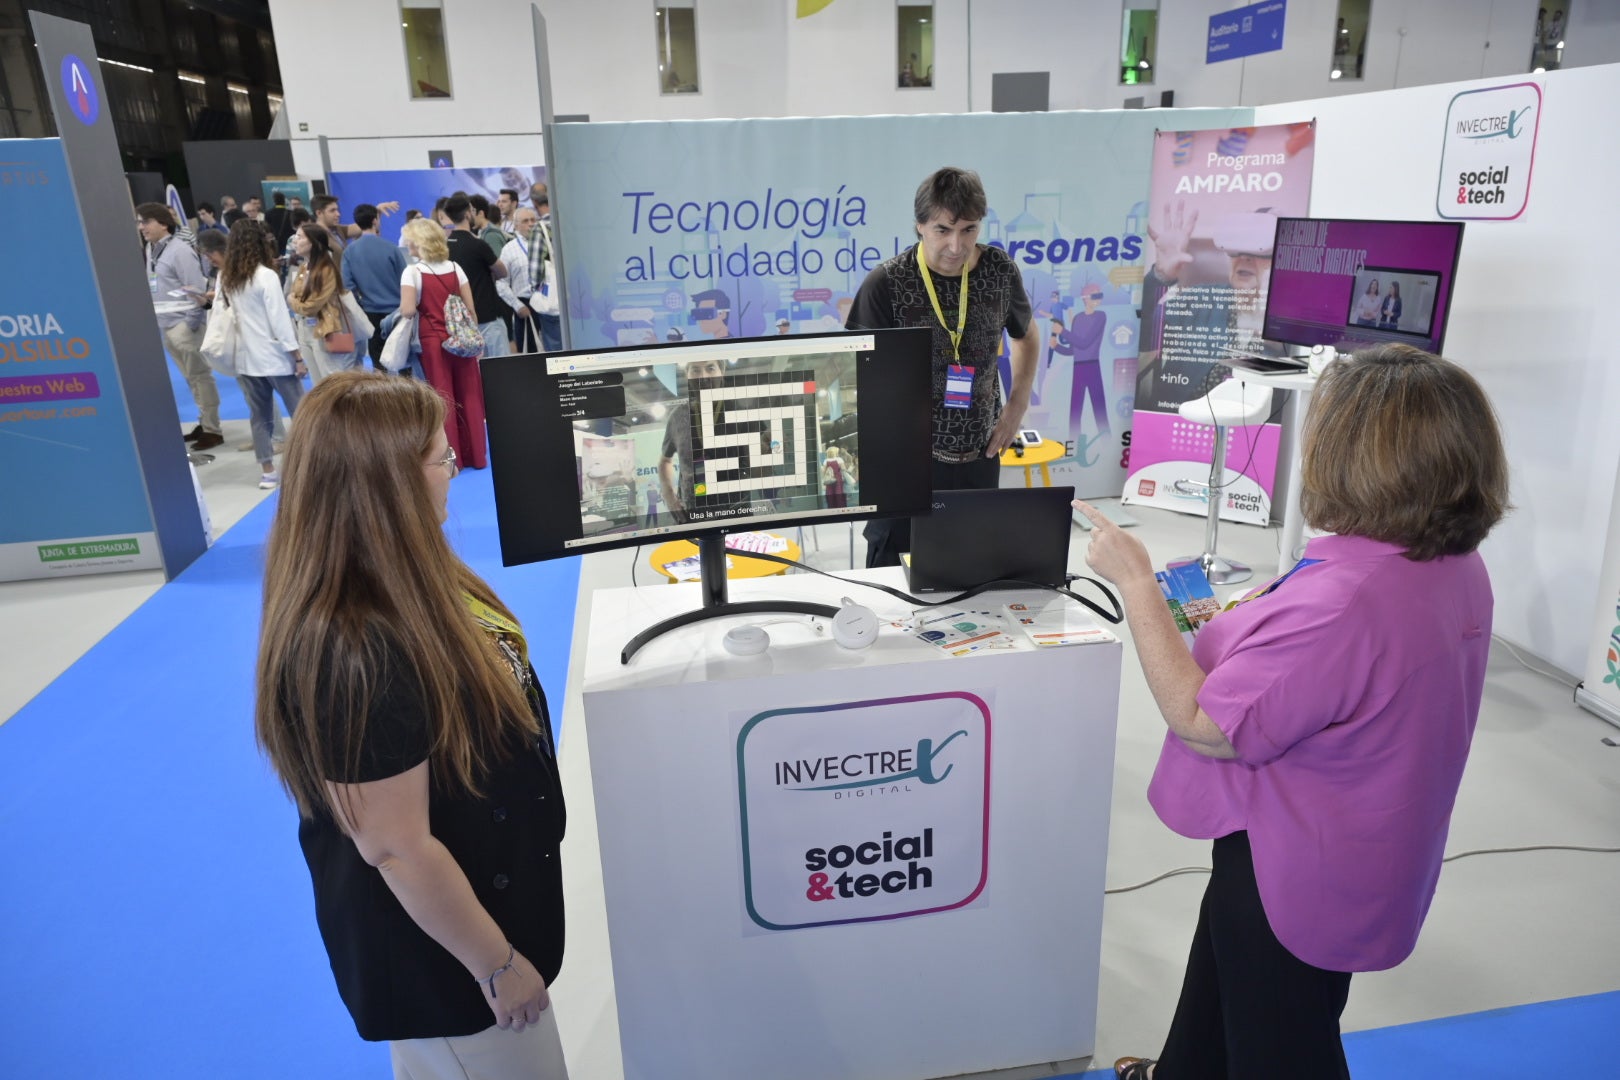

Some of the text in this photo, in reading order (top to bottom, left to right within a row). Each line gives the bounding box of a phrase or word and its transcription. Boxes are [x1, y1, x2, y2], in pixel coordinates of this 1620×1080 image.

[1207, 152, 1285, 171] Programa
[1174, 171, 1283, 194] AMPARO
[1458, 165, 1510, 185] social
[1456, 186, 1506, 204] &tech
[622, 185, 867, 239] Tecnología
[625, 246, 656, 282] al
[668, 240, 824, 280] cuidado
[834, 238, 882, 274] de
[989, 234, 1144, 266] rsonas
[1275, 246, 1368, 277] CONTENIDOS DIGITALES
[1211, 287, 1257, 295] biopsicosocial
[0, 312, 64, 338] ORIA
[1163, 323, 1183, 331] Asume
[1163, 333, 1207, 341] envejecimiento
[45, 376, 86, 394] Web
[1160, 372, 1190, 385] +info
[1226, 500, 1260, 513] &tech
[1227, 491, 1262, 504] social
[689, 512, 705, 520] Usa
[714, 509, 735, 517] mano
[737, 505, 769, 515] derecha.
[41, 542, 137, 559] JUNTA DE EXTREMADURA
[834, 785, 912, 800] DIGITAL
[804, 827, 933, 872] social
[805, 861, 933, 902] &tech
